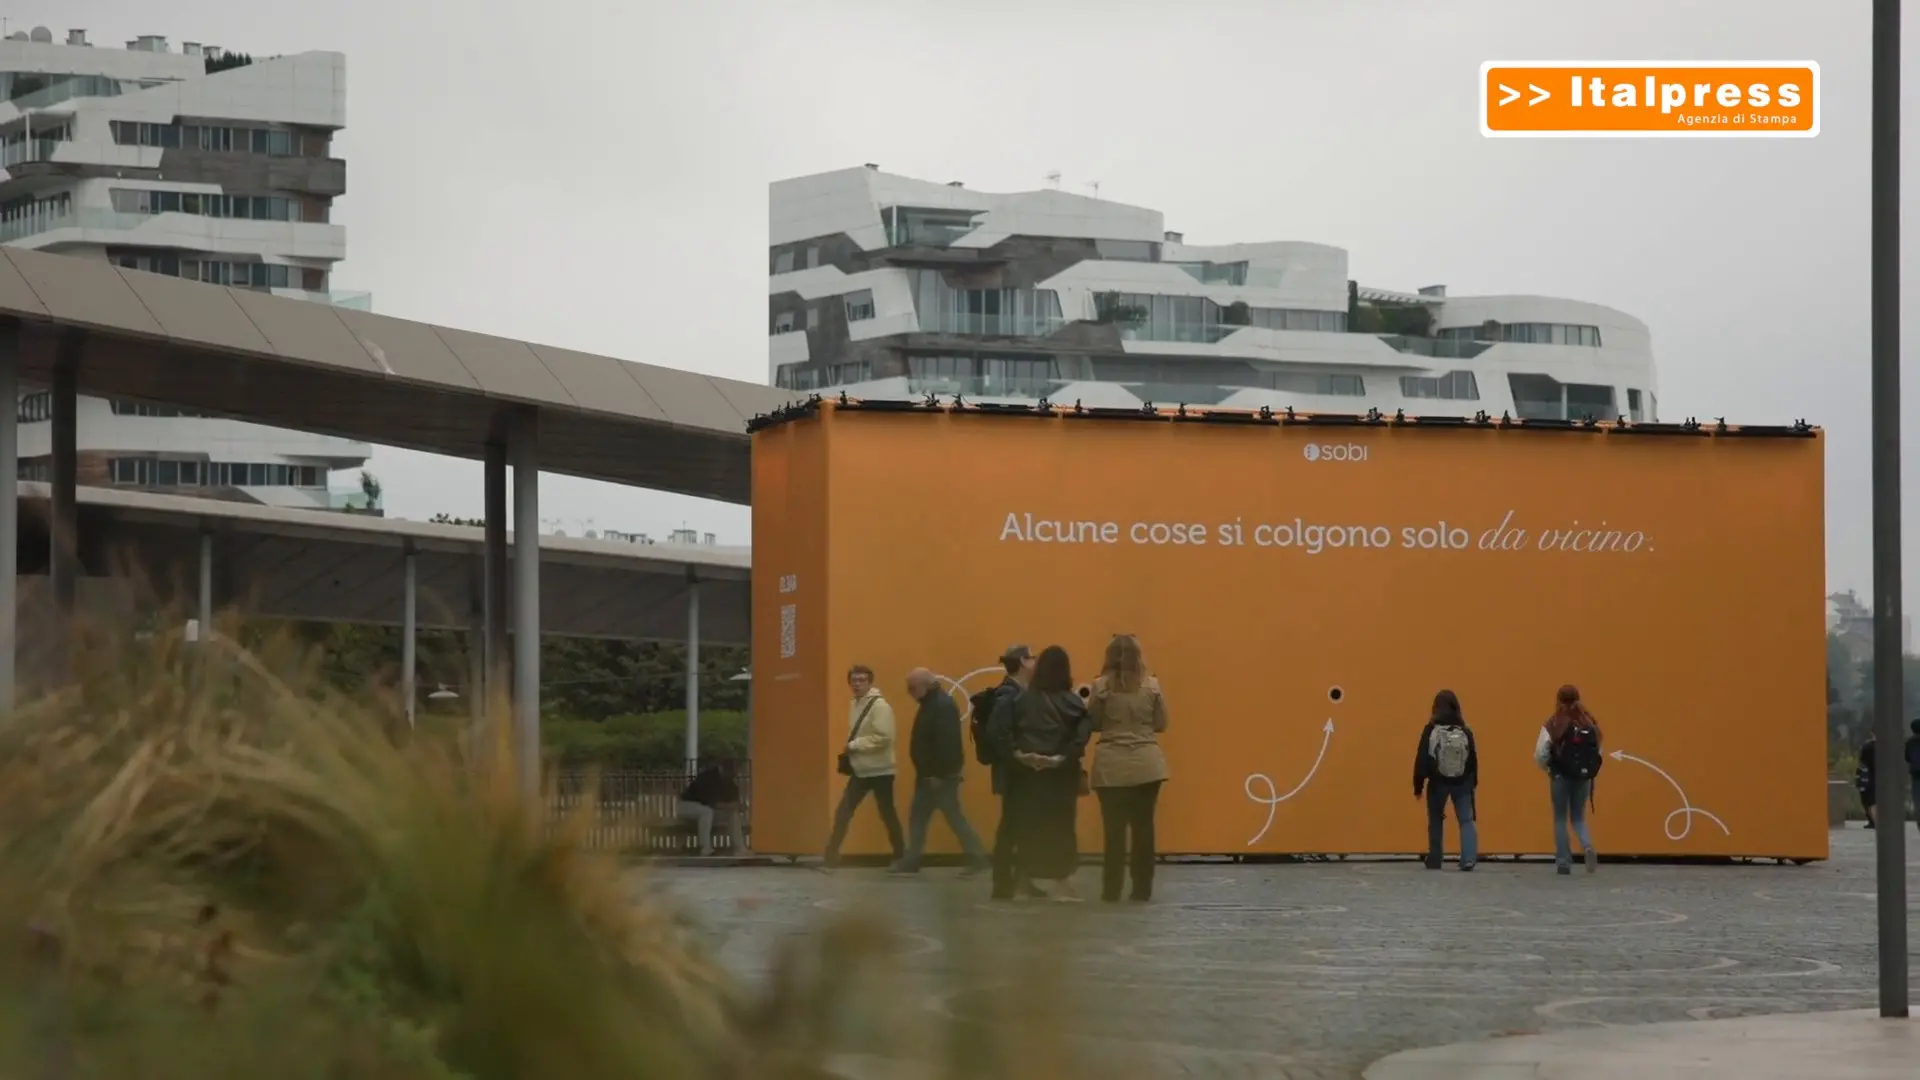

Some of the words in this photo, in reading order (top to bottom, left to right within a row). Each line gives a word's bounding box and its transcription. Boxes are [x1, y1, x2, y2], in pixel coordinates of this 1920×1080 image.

[1321, 442, 1369, 462] sobi
[999, 511, 1118, 545] Alcune
[1129, 521, 1208, 546] cose
[1217, 516, 1244, 546] si
[1253, 517, 1392, 555] colgono
[1401, 520, 1470, 550] solo
[1477, 509, 1528, 551] da
[1537, 520, 1656, 553] vicino.
